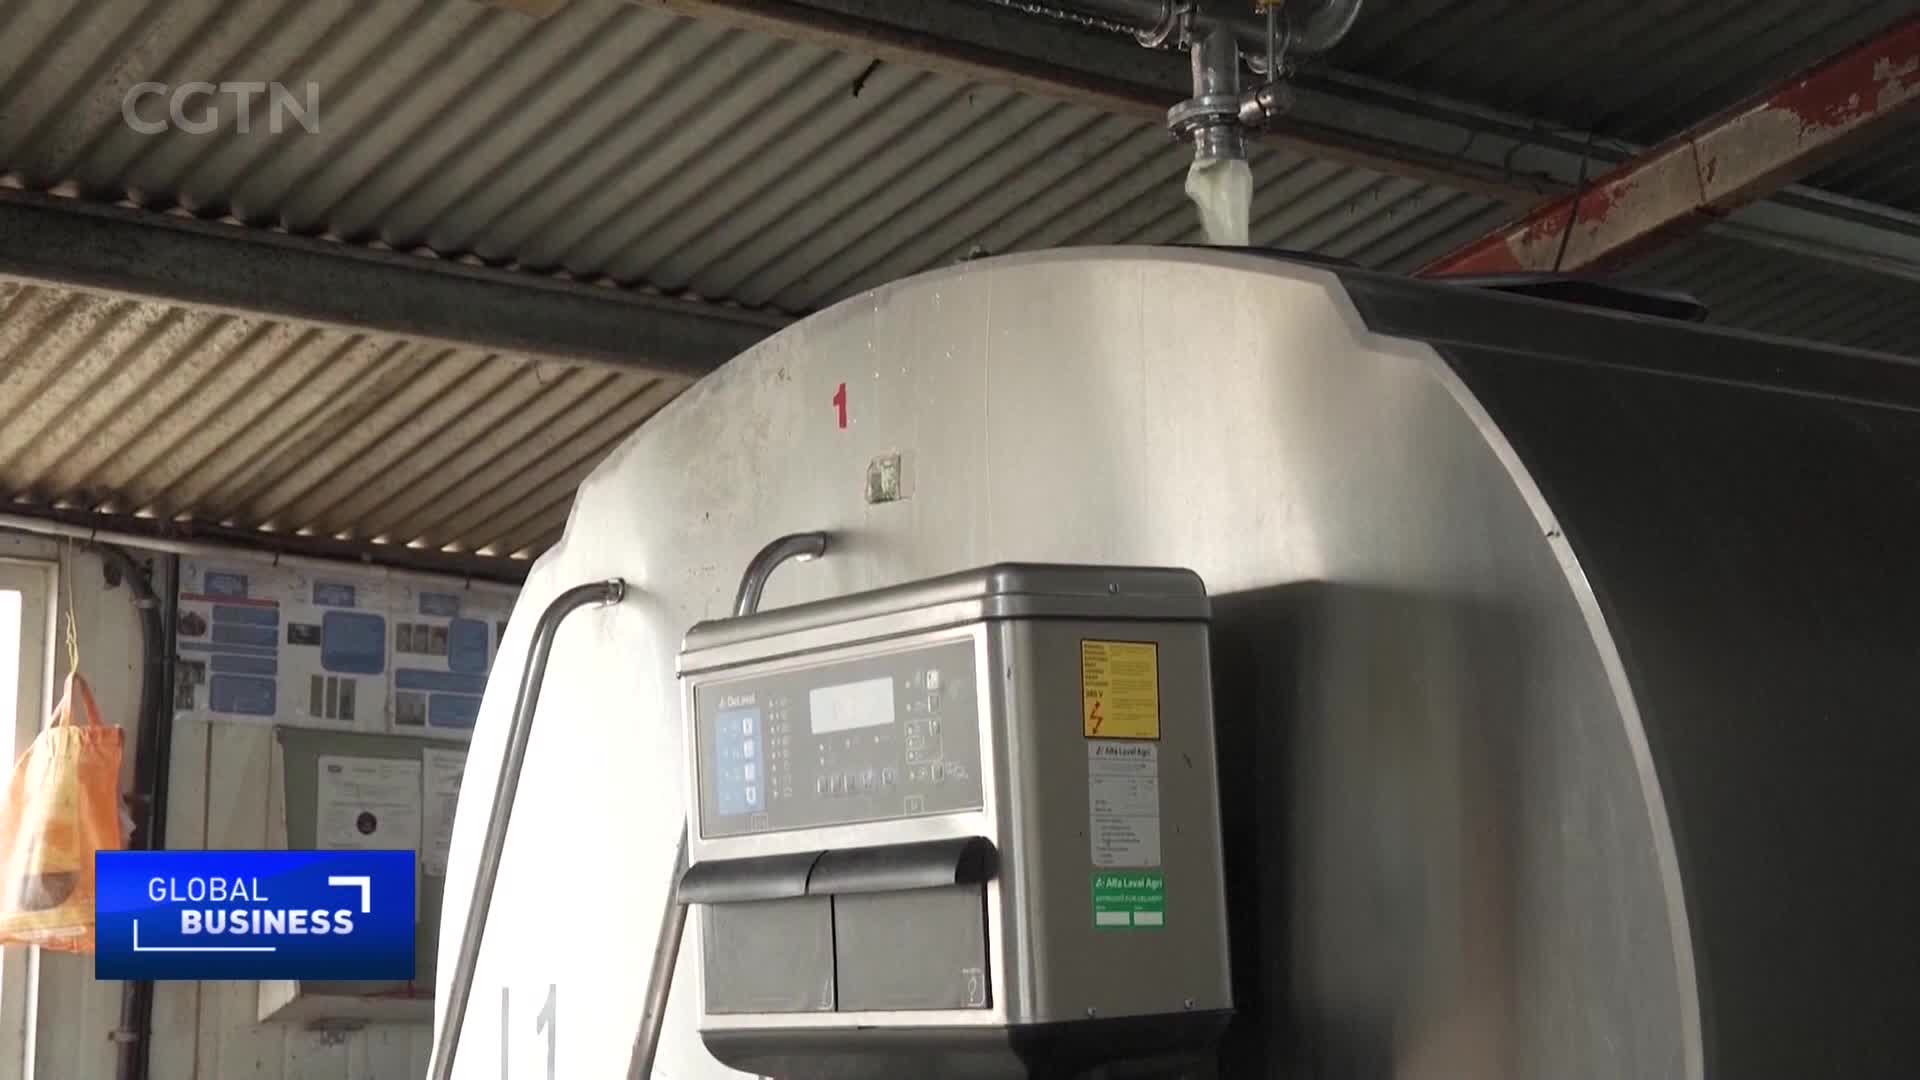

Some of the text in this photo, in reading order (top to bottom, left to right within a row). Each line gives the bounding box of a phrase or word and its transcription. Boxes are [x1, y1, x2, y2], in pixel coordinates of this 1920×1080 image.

[832, 382, 848, 429] 1
[1105, 877, 1162, 891] Alfa Laval Agri
